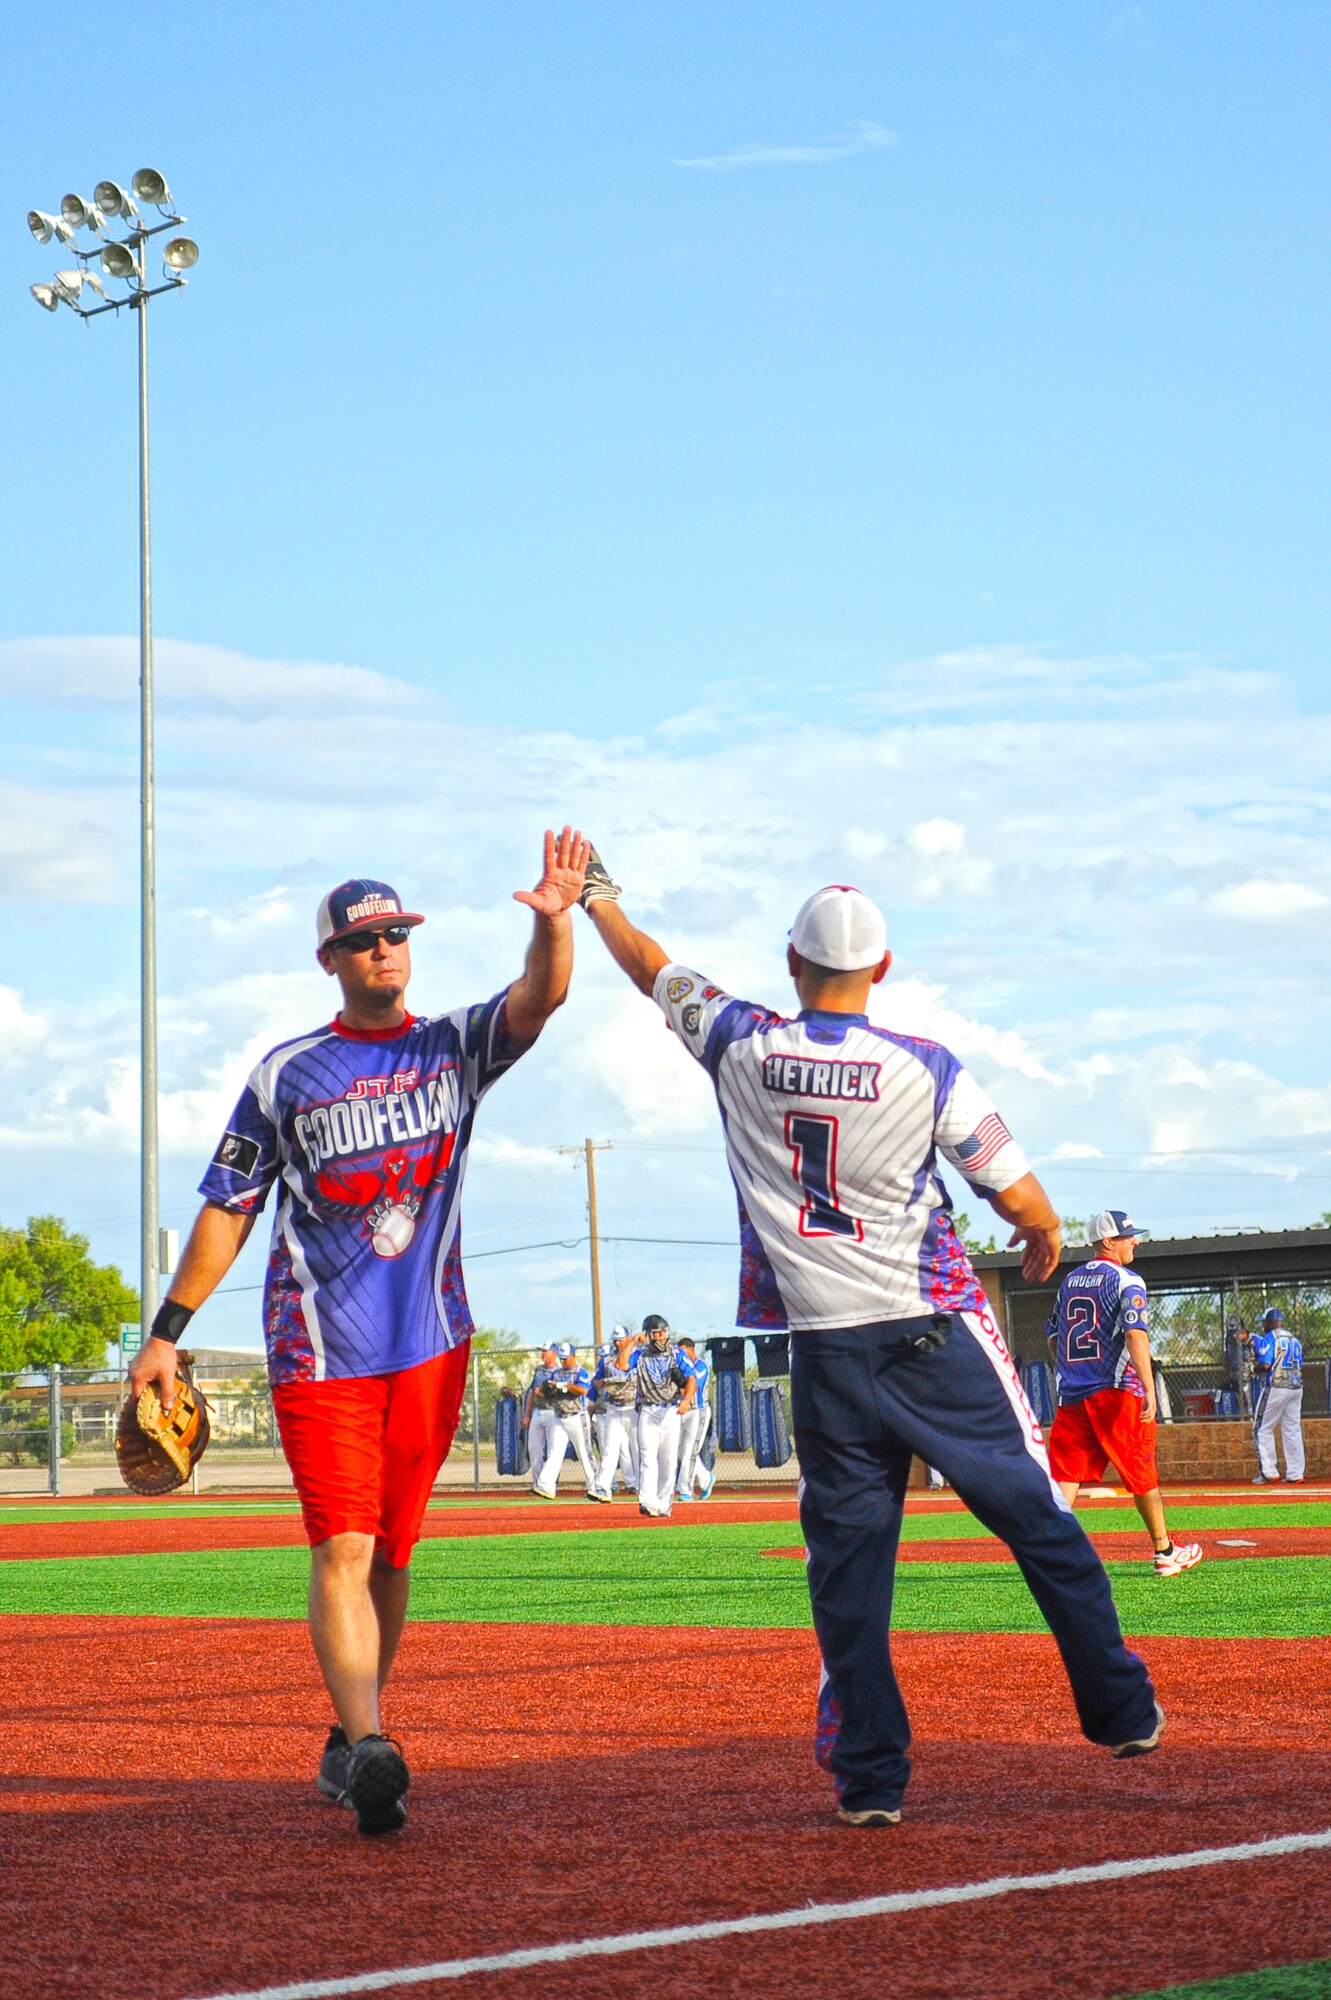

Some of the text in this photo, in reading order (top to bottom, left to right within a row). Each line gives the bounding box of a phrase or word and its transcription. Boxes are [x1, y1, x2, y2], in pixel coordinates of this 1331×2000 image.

[346, 899, 399, 922] GOODFELLOW
[361, 893, 382, 902] JTF
[346, 1071, 416, 1100] JTF
[766, 1057, 878, 1099] HETRICK
[294, 1069, 460, 1172] GOODFELLOW
[785, 1111, 863, 1242] 1
[1067, 1275, 1104, 1289] VAUGHN
[1067, 1296, 1100, 1362] 2
